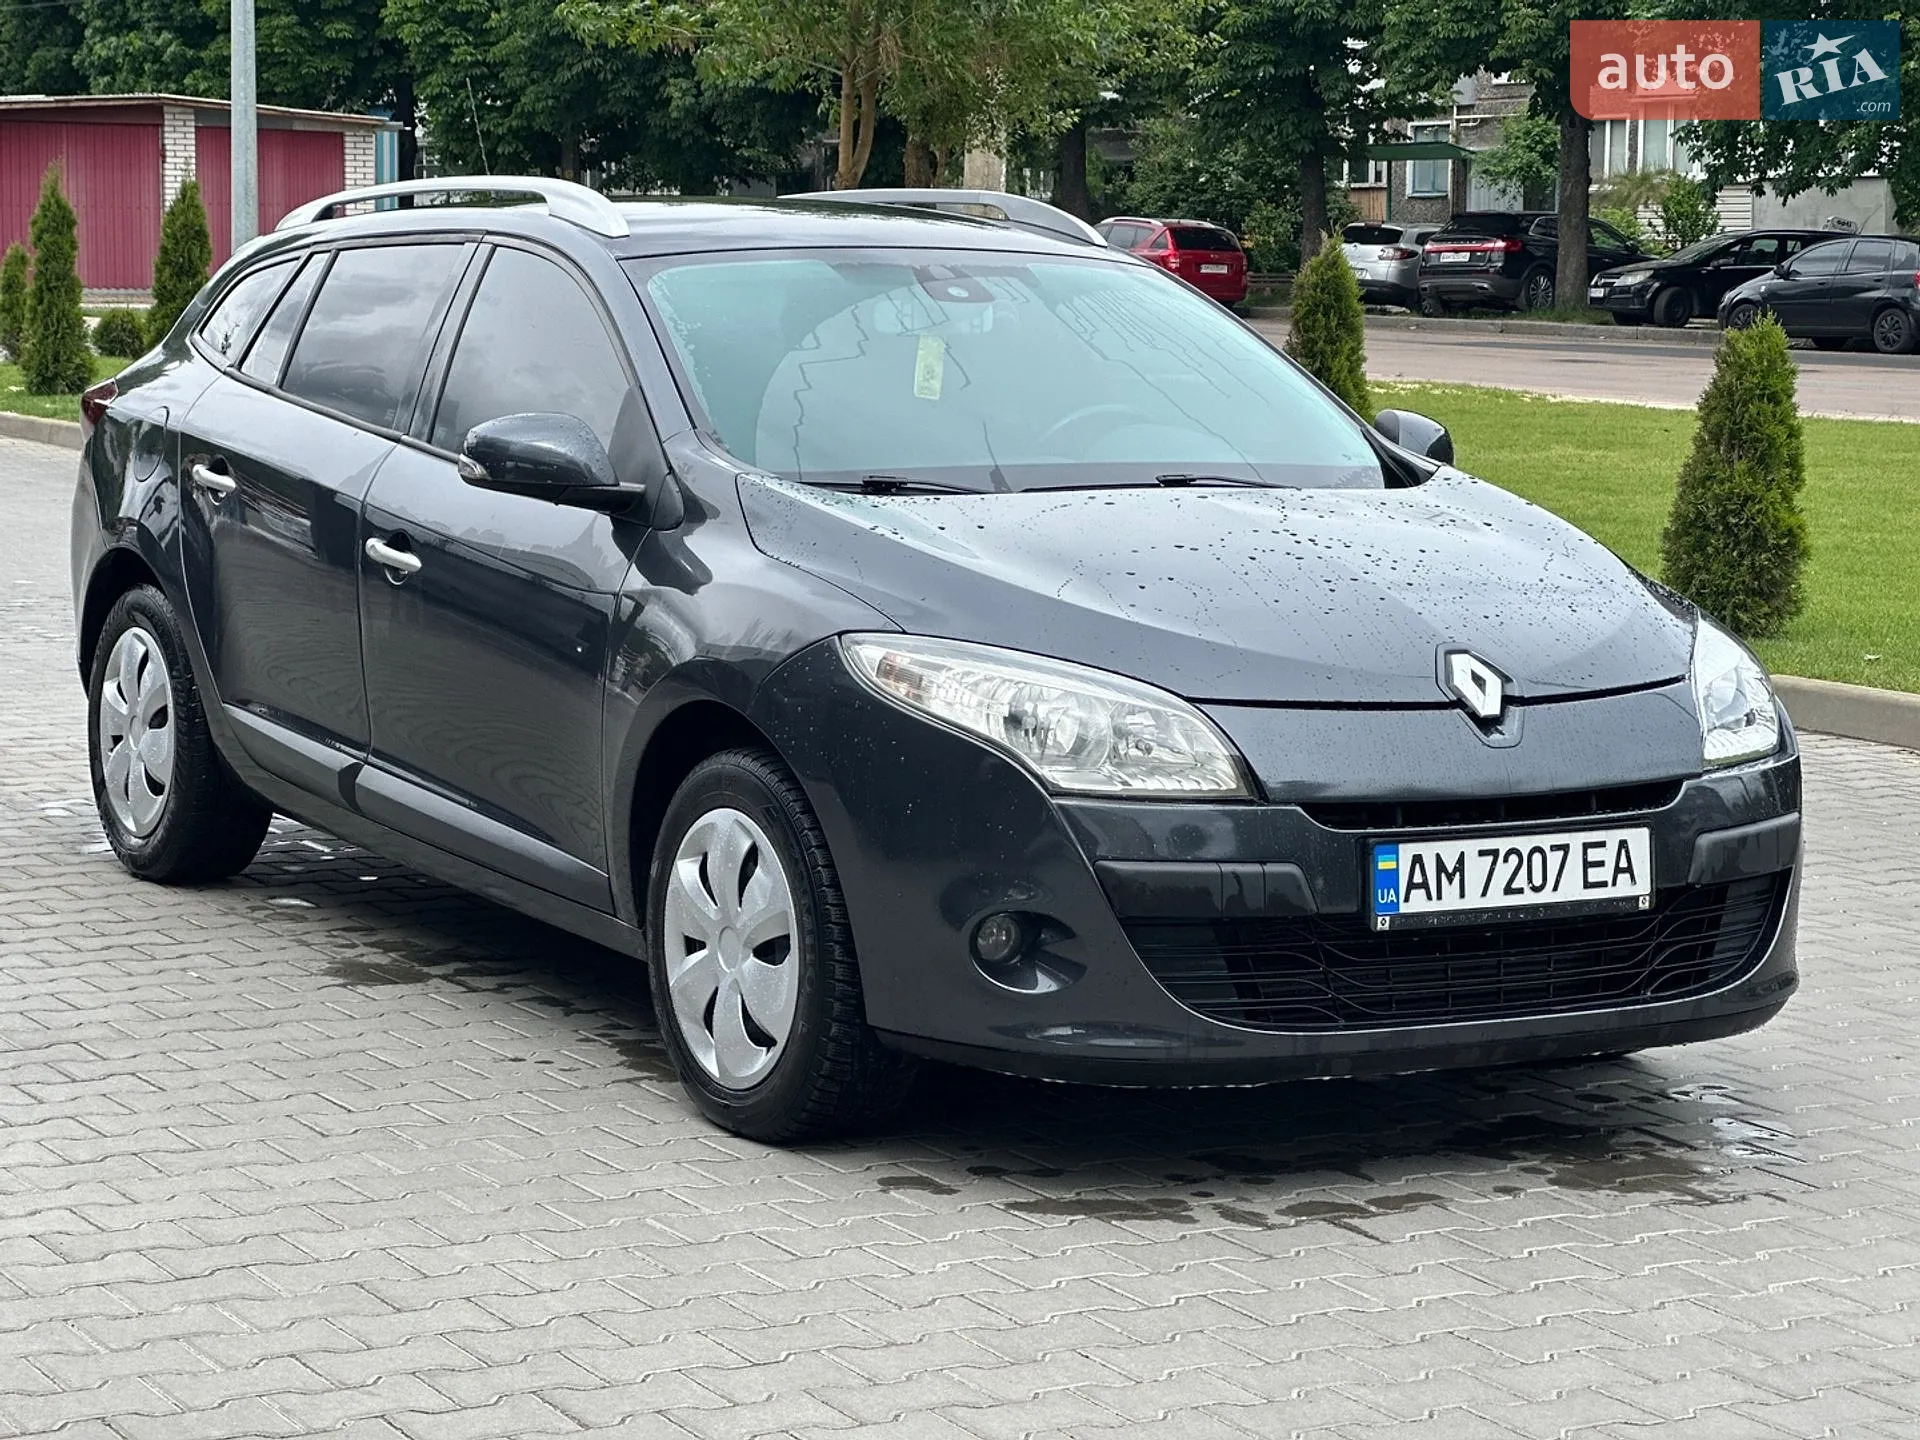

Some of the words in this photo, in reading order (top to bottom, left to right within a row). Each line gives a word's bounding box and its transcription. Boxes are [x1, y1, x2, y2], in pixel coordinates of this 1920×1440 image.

[1403, 850, 1466, 903] AM
[1477, 843, 1571, 898] 7207
[1582, 839, 1637, 890] EA
[1378, 887, 1397, 904] UA
